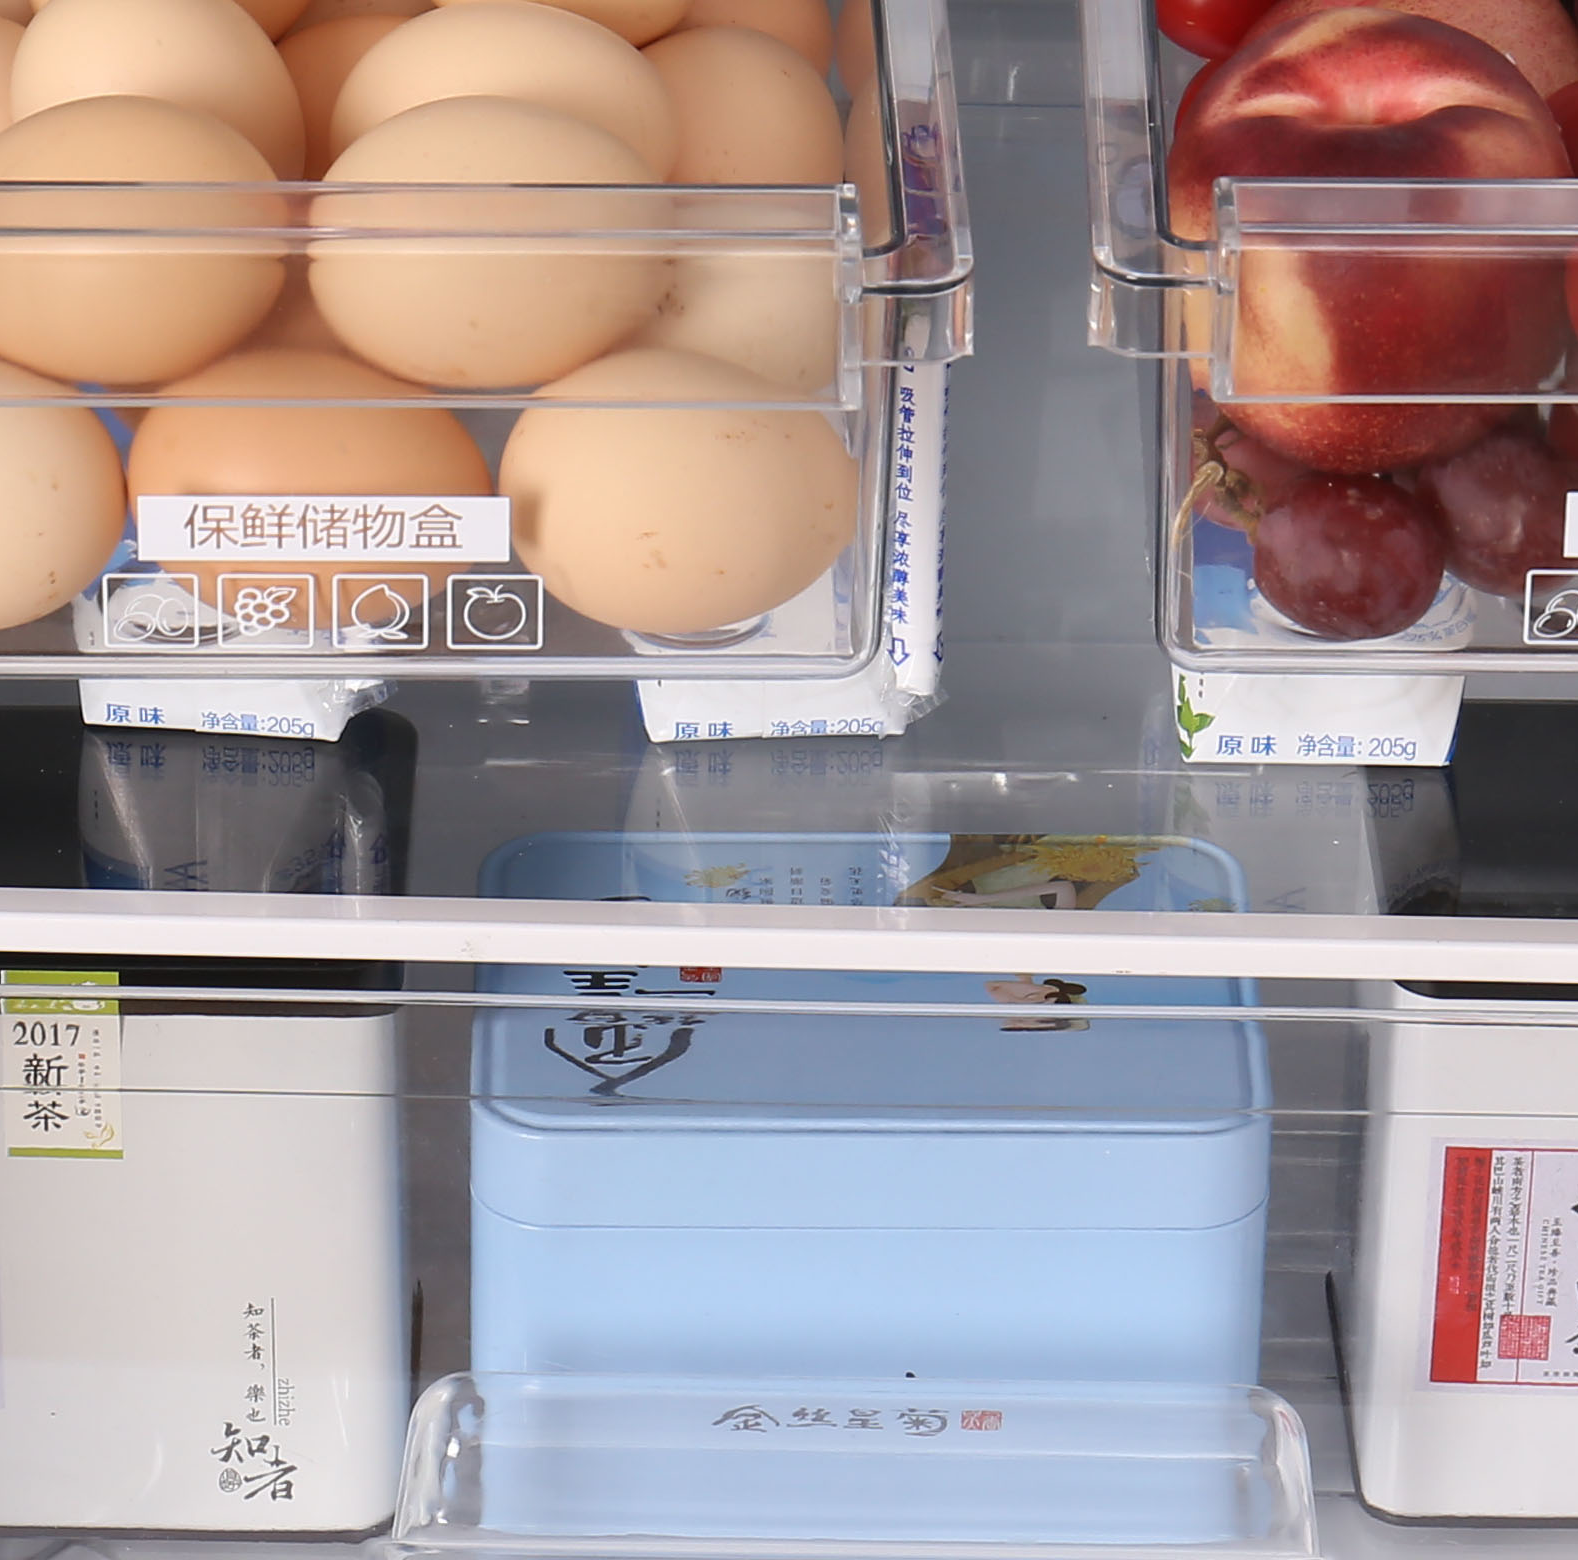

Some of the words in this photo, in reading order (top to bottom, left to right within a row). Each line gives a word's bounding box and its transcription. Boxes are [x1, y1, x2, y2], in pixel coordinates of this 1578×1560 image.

[896, 386, 916, 502] 吸管拉伸到位
[183, 502, 463, 550] 保鲜储物盒
[106, 704, 165, 724] 原味
[202, 712, 315, 739] 净含量:205g
[674, 721, 733, 739] 原味
[1217, 736, 1277, 756] 原味
[12, 1021, 81, 1046] 2017
[277, 1378, 296, 1427] zhizhe
[210, 1421, 298, 1501] 知者
